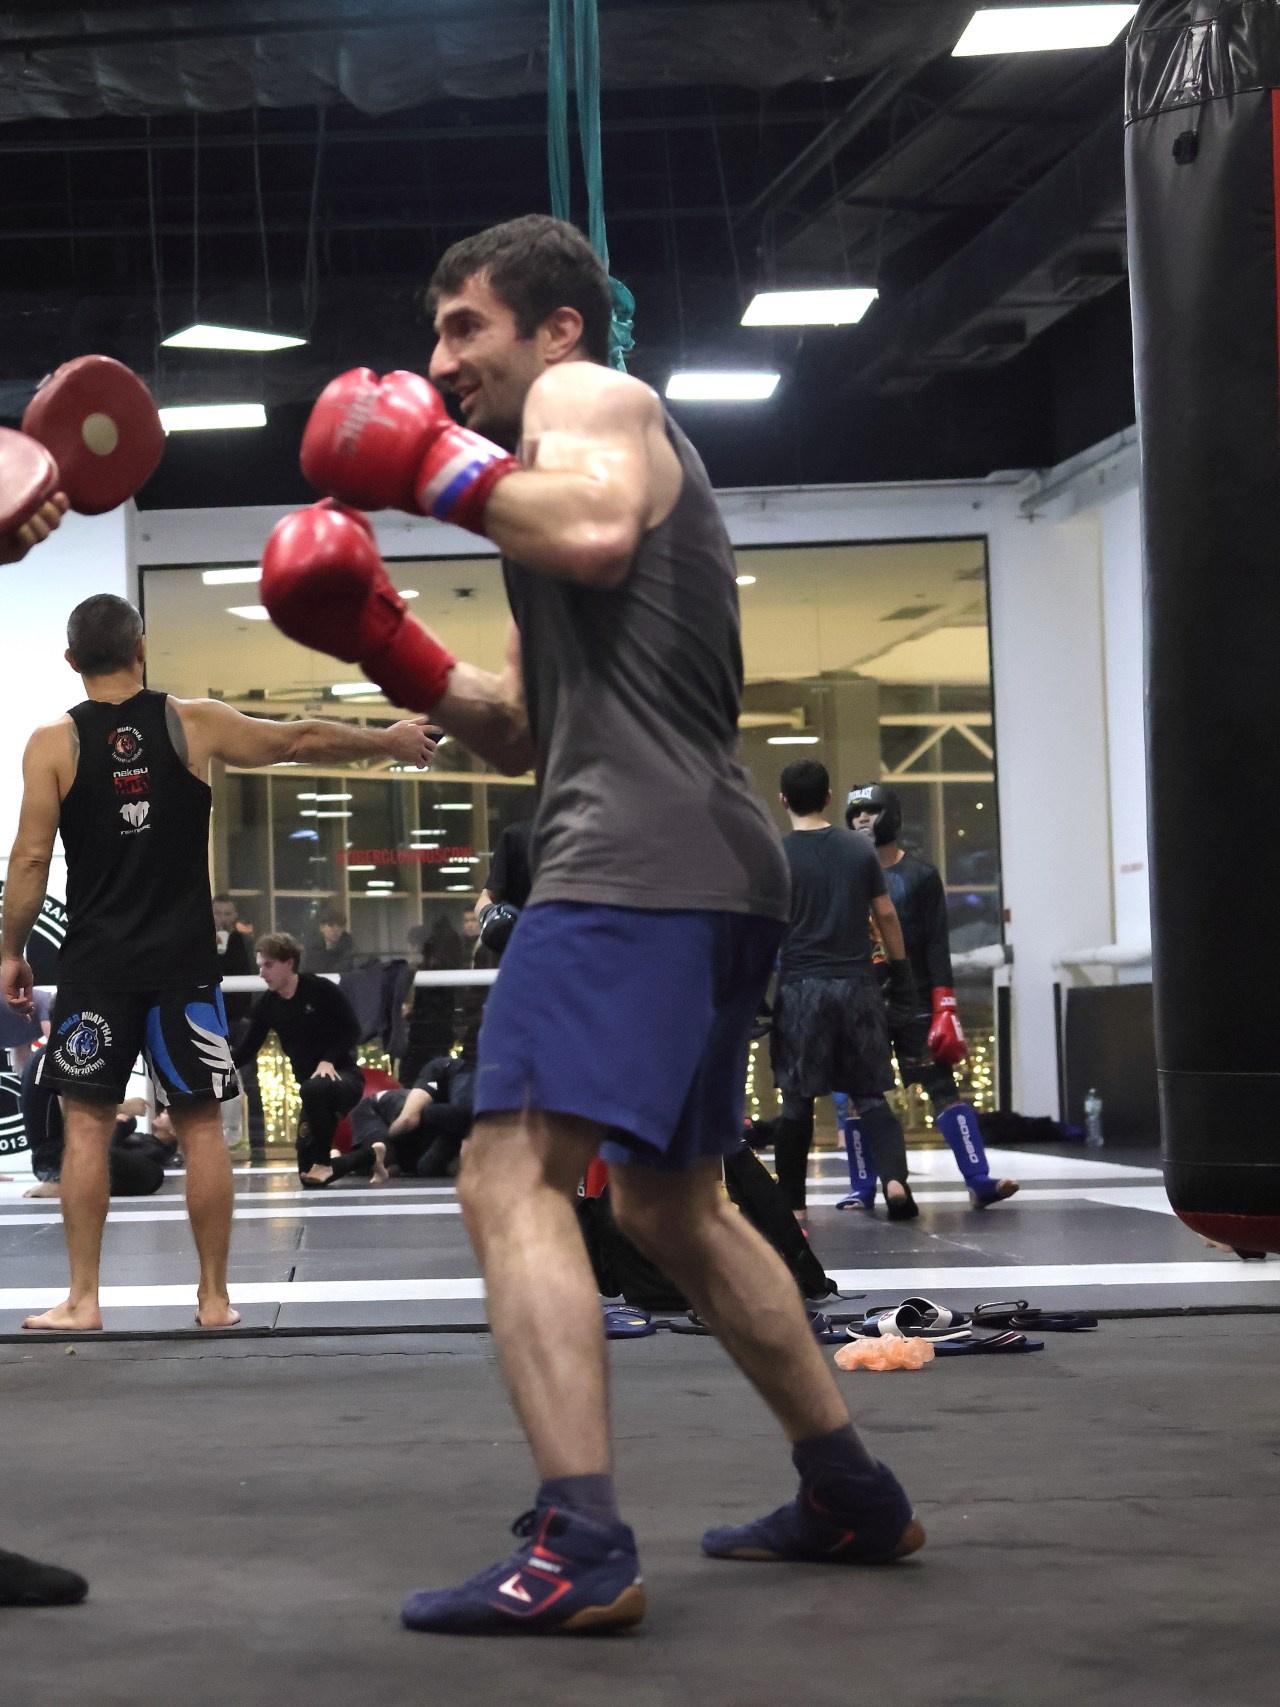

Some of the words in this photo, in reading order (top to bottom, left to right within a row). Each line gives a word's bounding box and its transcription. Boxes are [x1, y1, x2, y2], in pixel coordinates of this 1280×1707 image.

[57, 1013, 80, 1035] TIGER
[81, 1011, 105, 1025] MUAY
[100, 1022, 113, 1047] THAI
